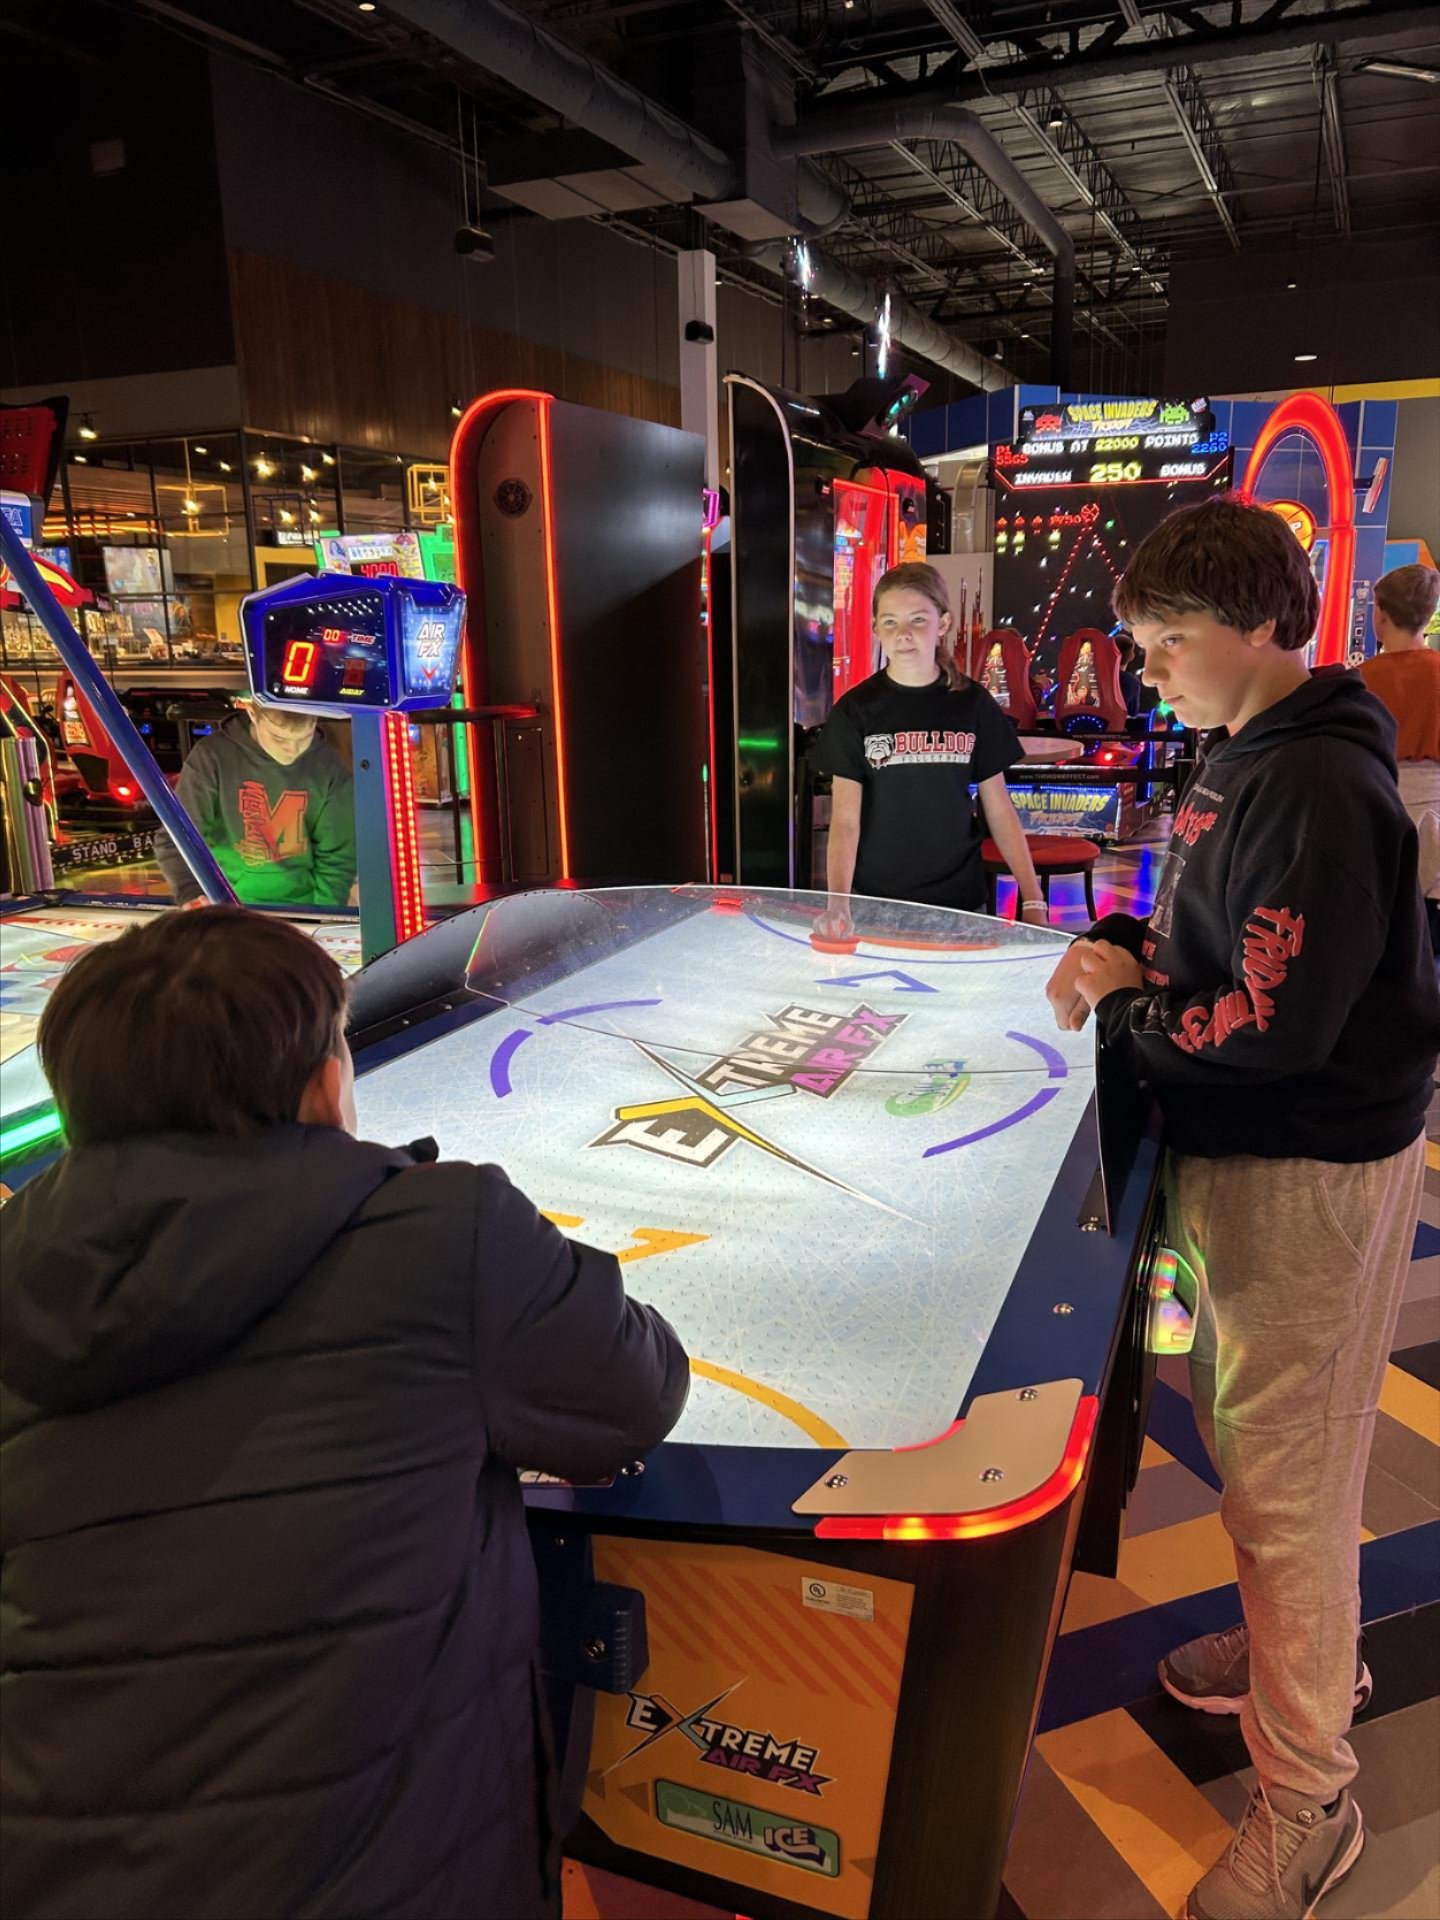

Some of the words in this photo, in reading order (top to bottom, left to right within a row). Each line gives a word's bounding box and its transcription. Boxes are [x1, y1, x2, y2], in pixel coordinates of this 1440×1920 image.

[1068, 404, 1102, 421] SPACE
[1103, 400, 1158, 418] INVADERS
[1022, 442, 1064, 454] BONUS
[1095, 436, 1139, 451] 22000
[1144, 433, 1199, 448] POINTS
[1089, 462, 1142, 482] 250
[1160, 463, 1206, 477] BONUS
[417, 622, 445, 640] AIR
[417, 642, 442, 657] FX
[1010, 792, 1048, 810] SPACE
[1049, 793, 1111, 812] INVADERS
[72, 842, 117, 860] STAND
[133, 836, 157, 848] BA
[626, 1686, 814, 1771] EXTREME
[705, 1749, 761, 1775] AIR
[767, 1763, 829, 1795] FX
[712, 1801, 753, 1840] SAM
[764, 1826, 826, 1866] ICE
